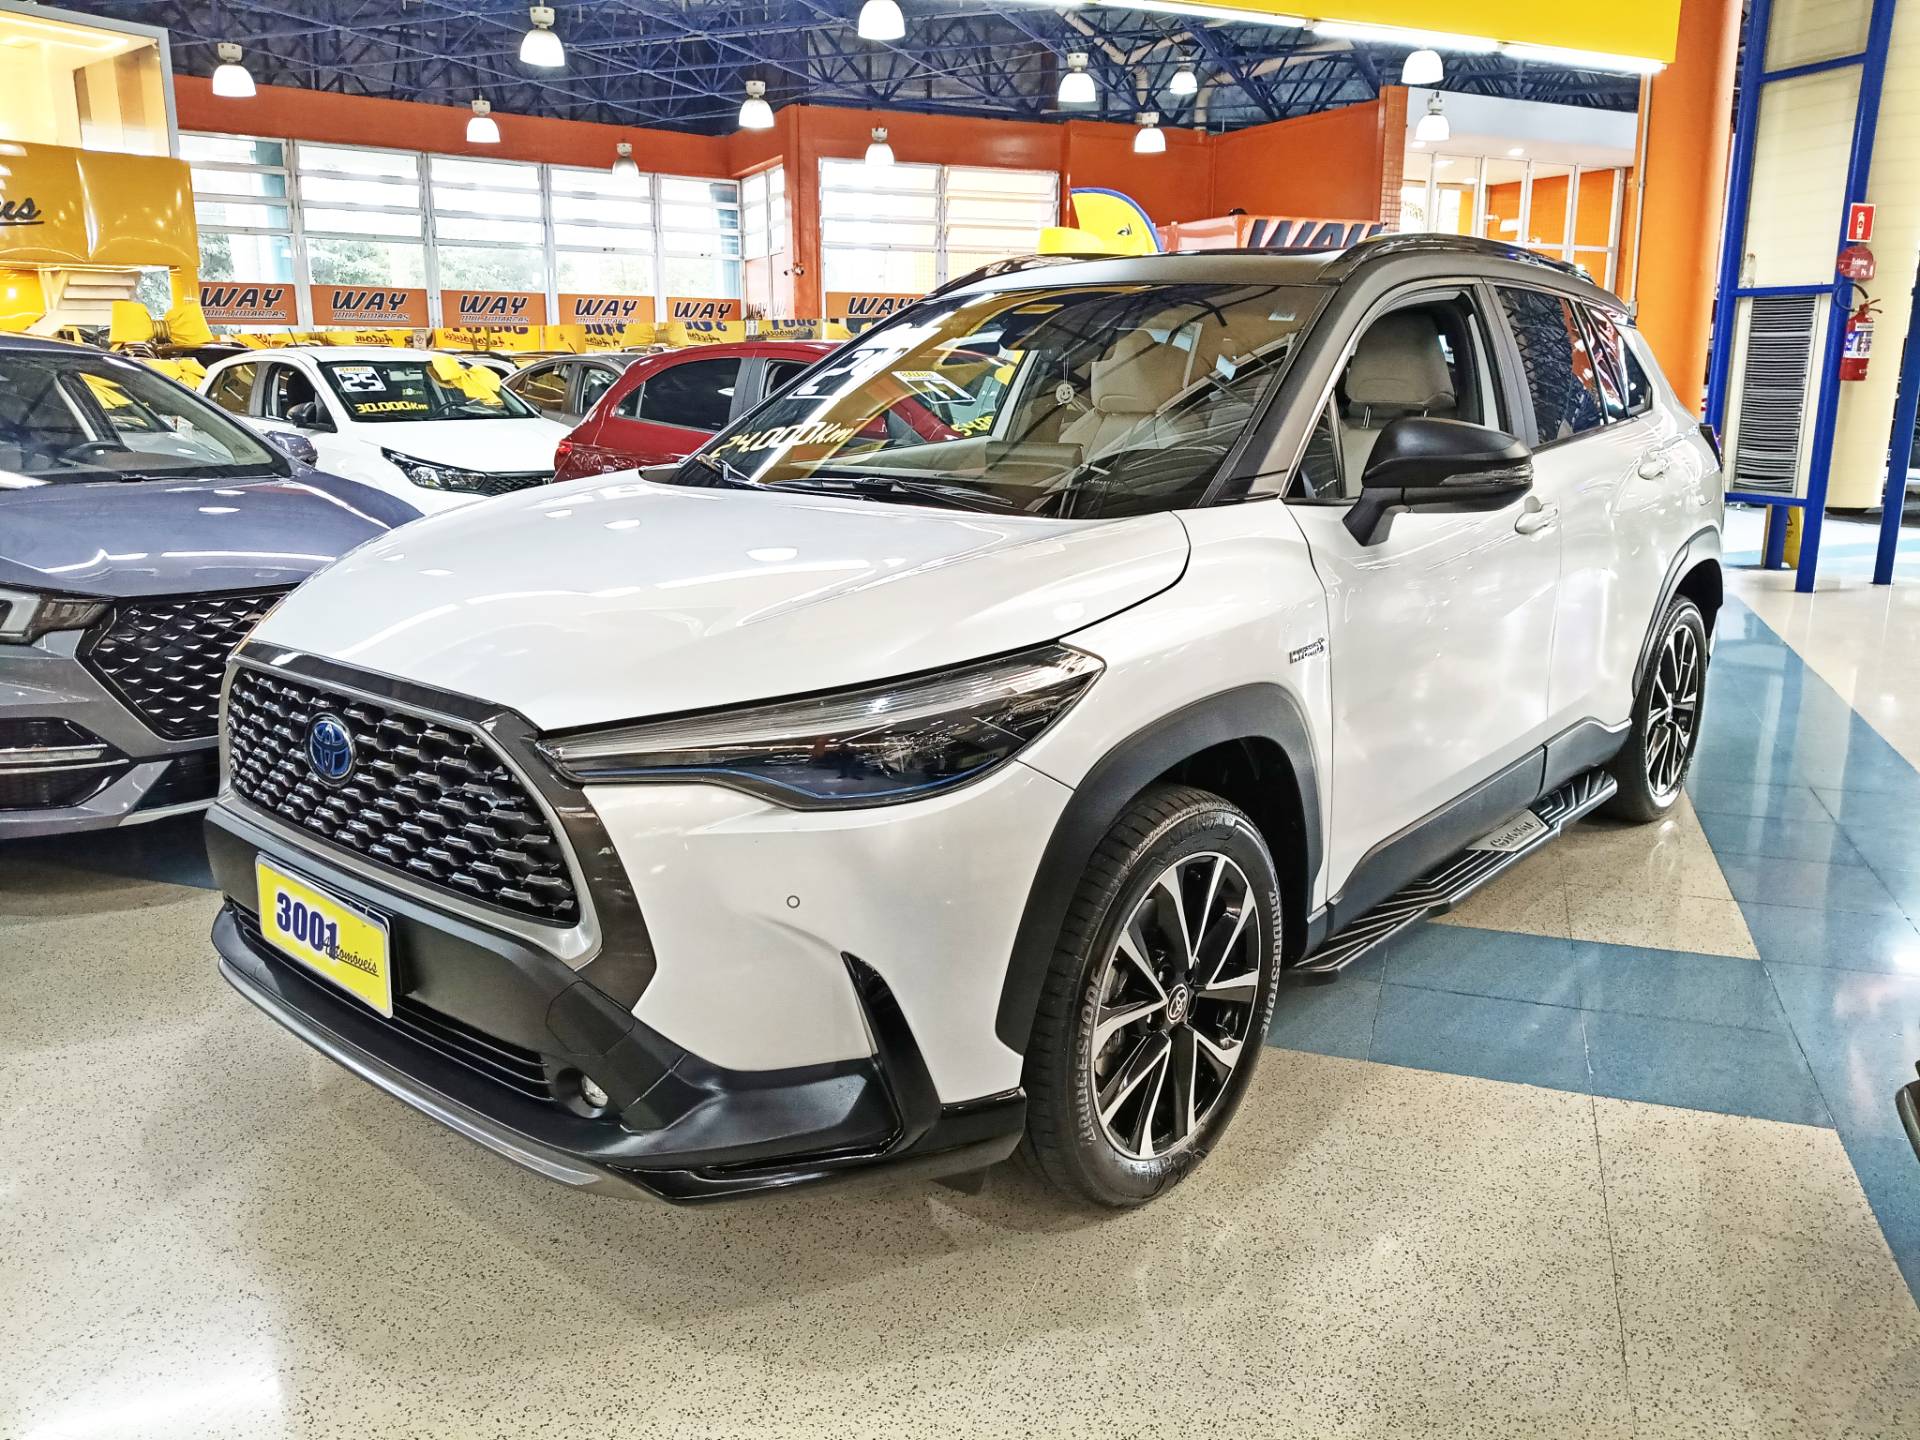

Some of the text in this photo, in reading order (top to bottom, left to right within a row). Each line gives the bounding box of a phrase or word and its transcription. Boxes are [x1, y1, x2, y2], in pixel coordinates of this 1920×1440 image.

[200, 287, 284, 308] WAY
[333, 290, 407, 311] WAY
[460, 295, 528, 314] WAY
[575, 299, 639, 317] WAY
[674, 302, 732, 319] WAY
[341, 373, 379, 390] 25
[276, 891, 338, 961] 3001
[323, 936, 378, 974] Automóveis
